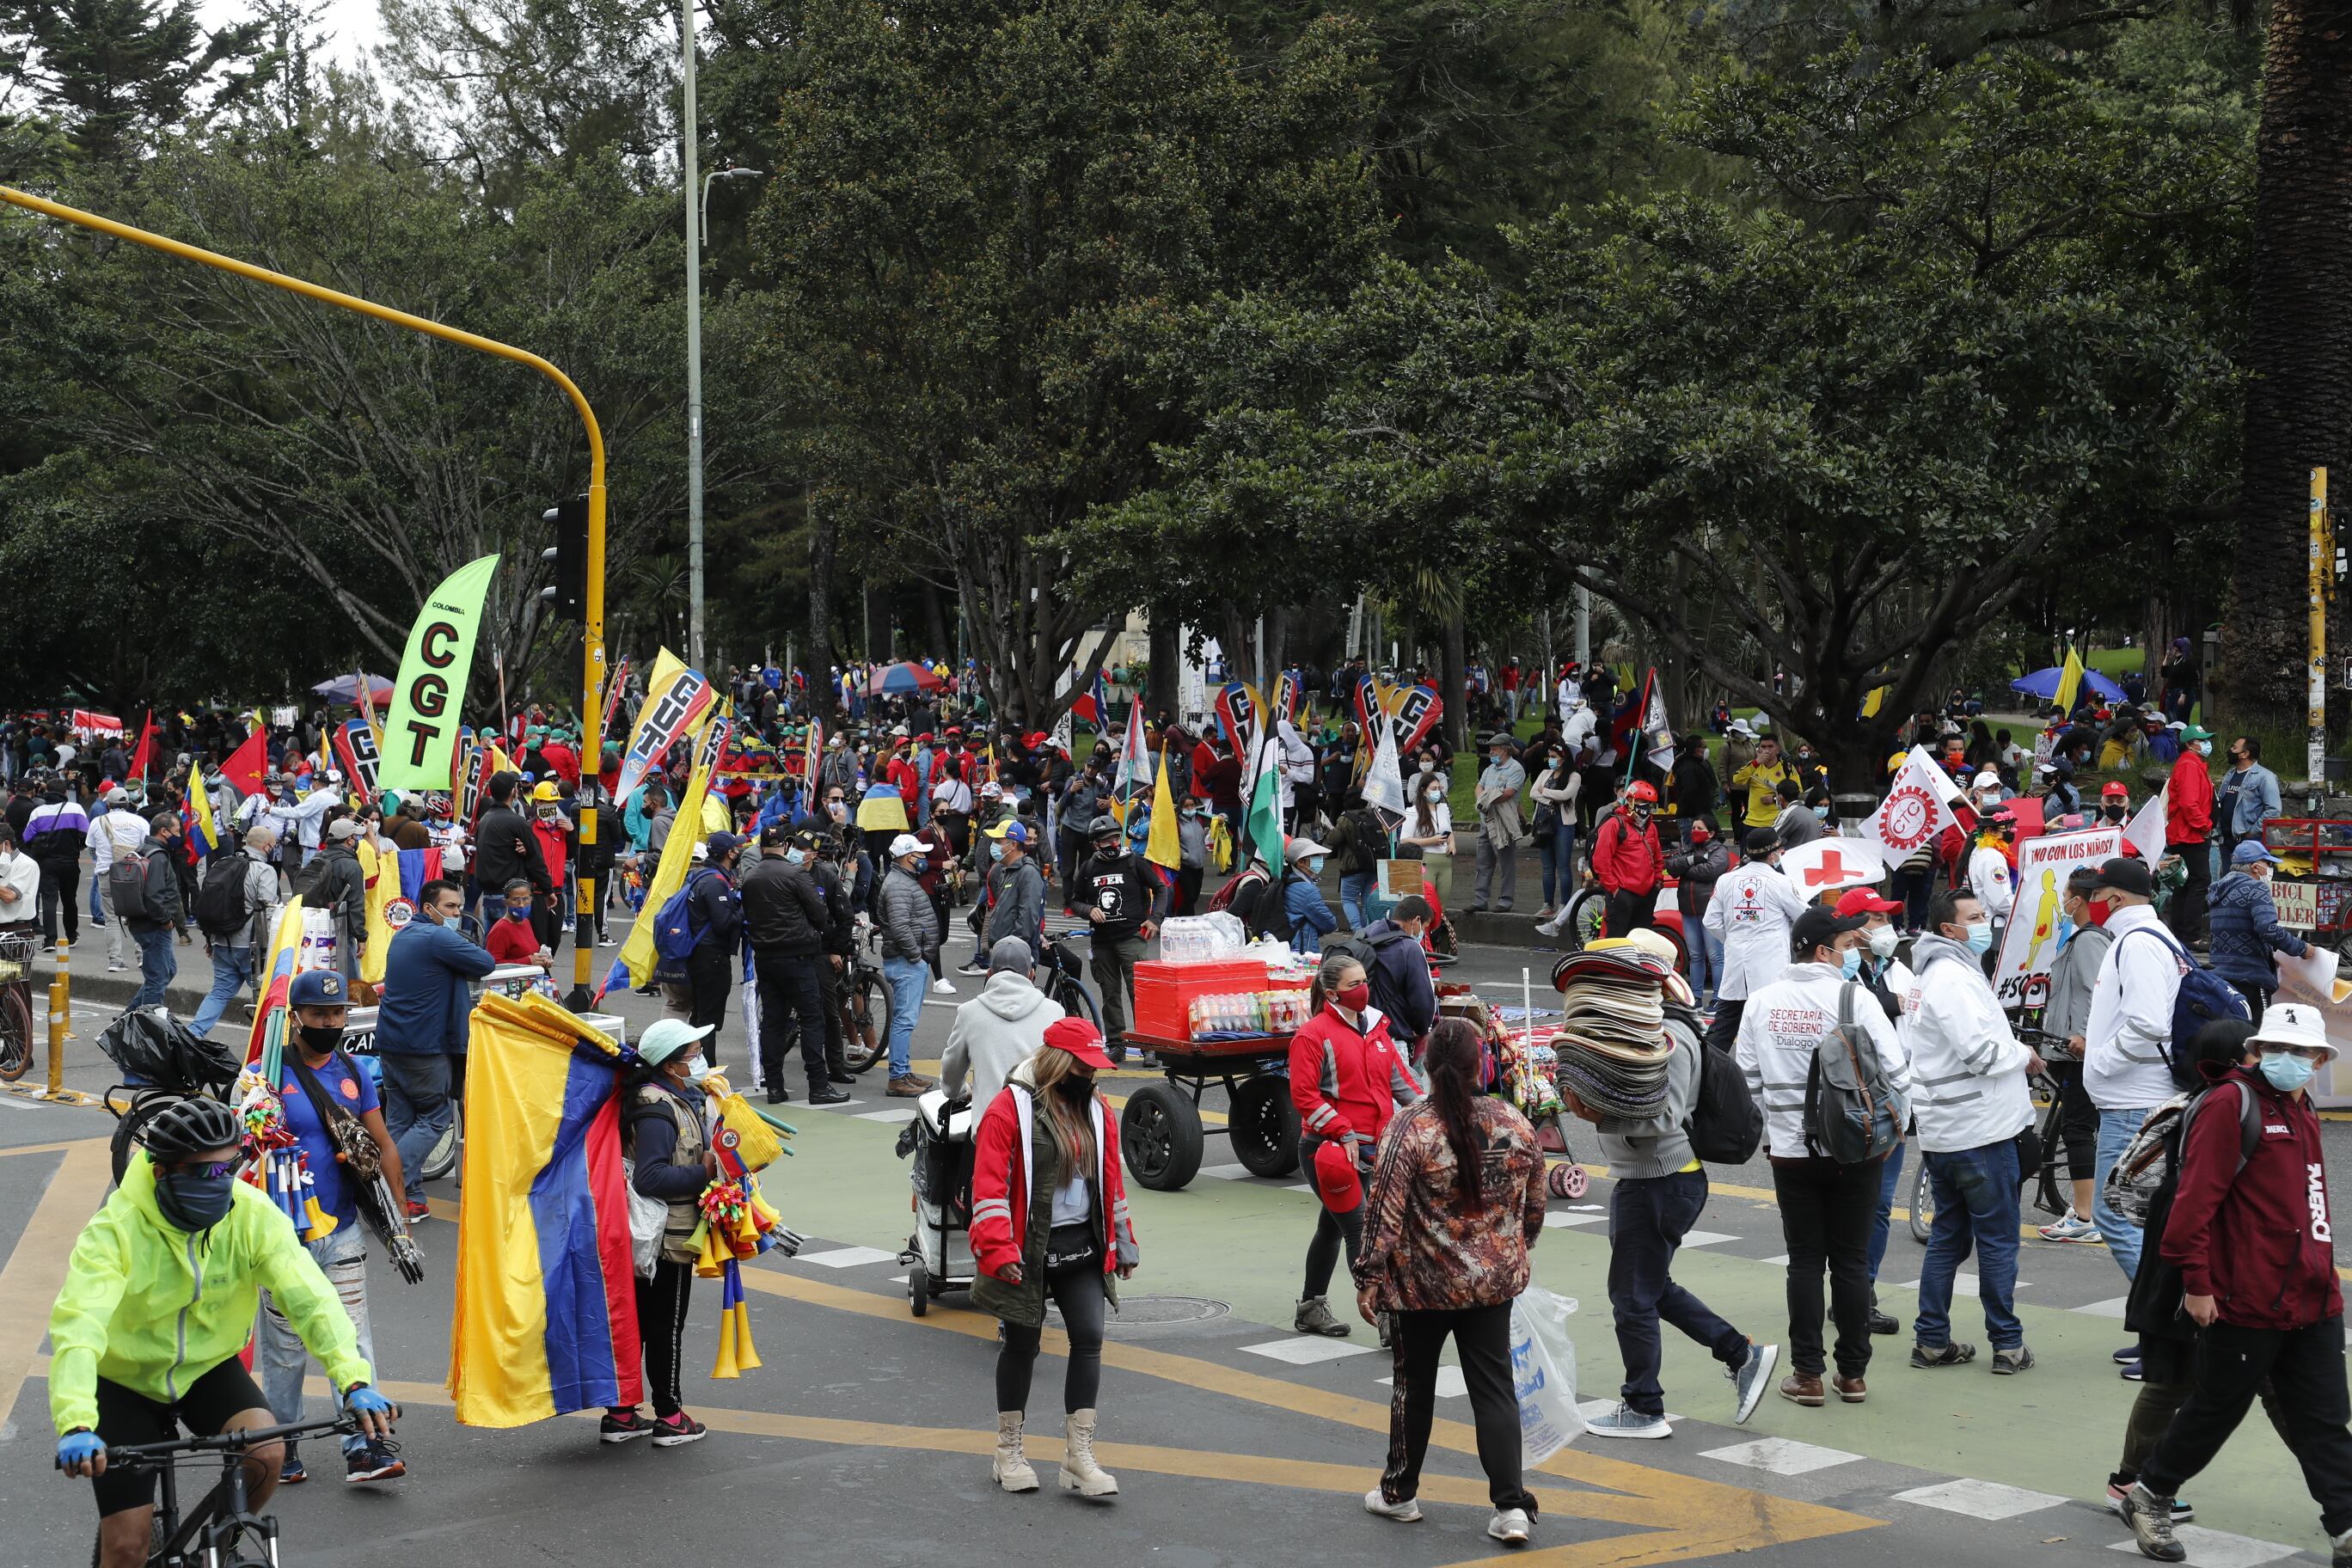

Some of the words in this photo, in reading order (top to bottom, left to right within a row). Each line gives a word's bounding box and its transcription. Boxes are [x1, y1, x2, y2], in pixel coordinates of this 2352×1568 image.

[432, 602, 465, 616] COLOMBIA
[407, 622, 459, 768] CGT
[634, 673, 702, 760] CUT
[1893, 801, 1920, 835] CTC
[1911, 819, 1931, 842] COLOMBIA
[2032, 847, 2047, 865] ¡NO
[2048, 844, 2067, 861] CON
[2069, 842, 2085, 859] LOS
[2086, 838, 2114, 857] NIÑOS!
[2271, 883, 2304, 900] BICI
[2277, 906, 2315, 924] LLER
[1768, 1020, 1779, 1032] DE
[1781, 1021, 1822, 1035] GOBIERNO
